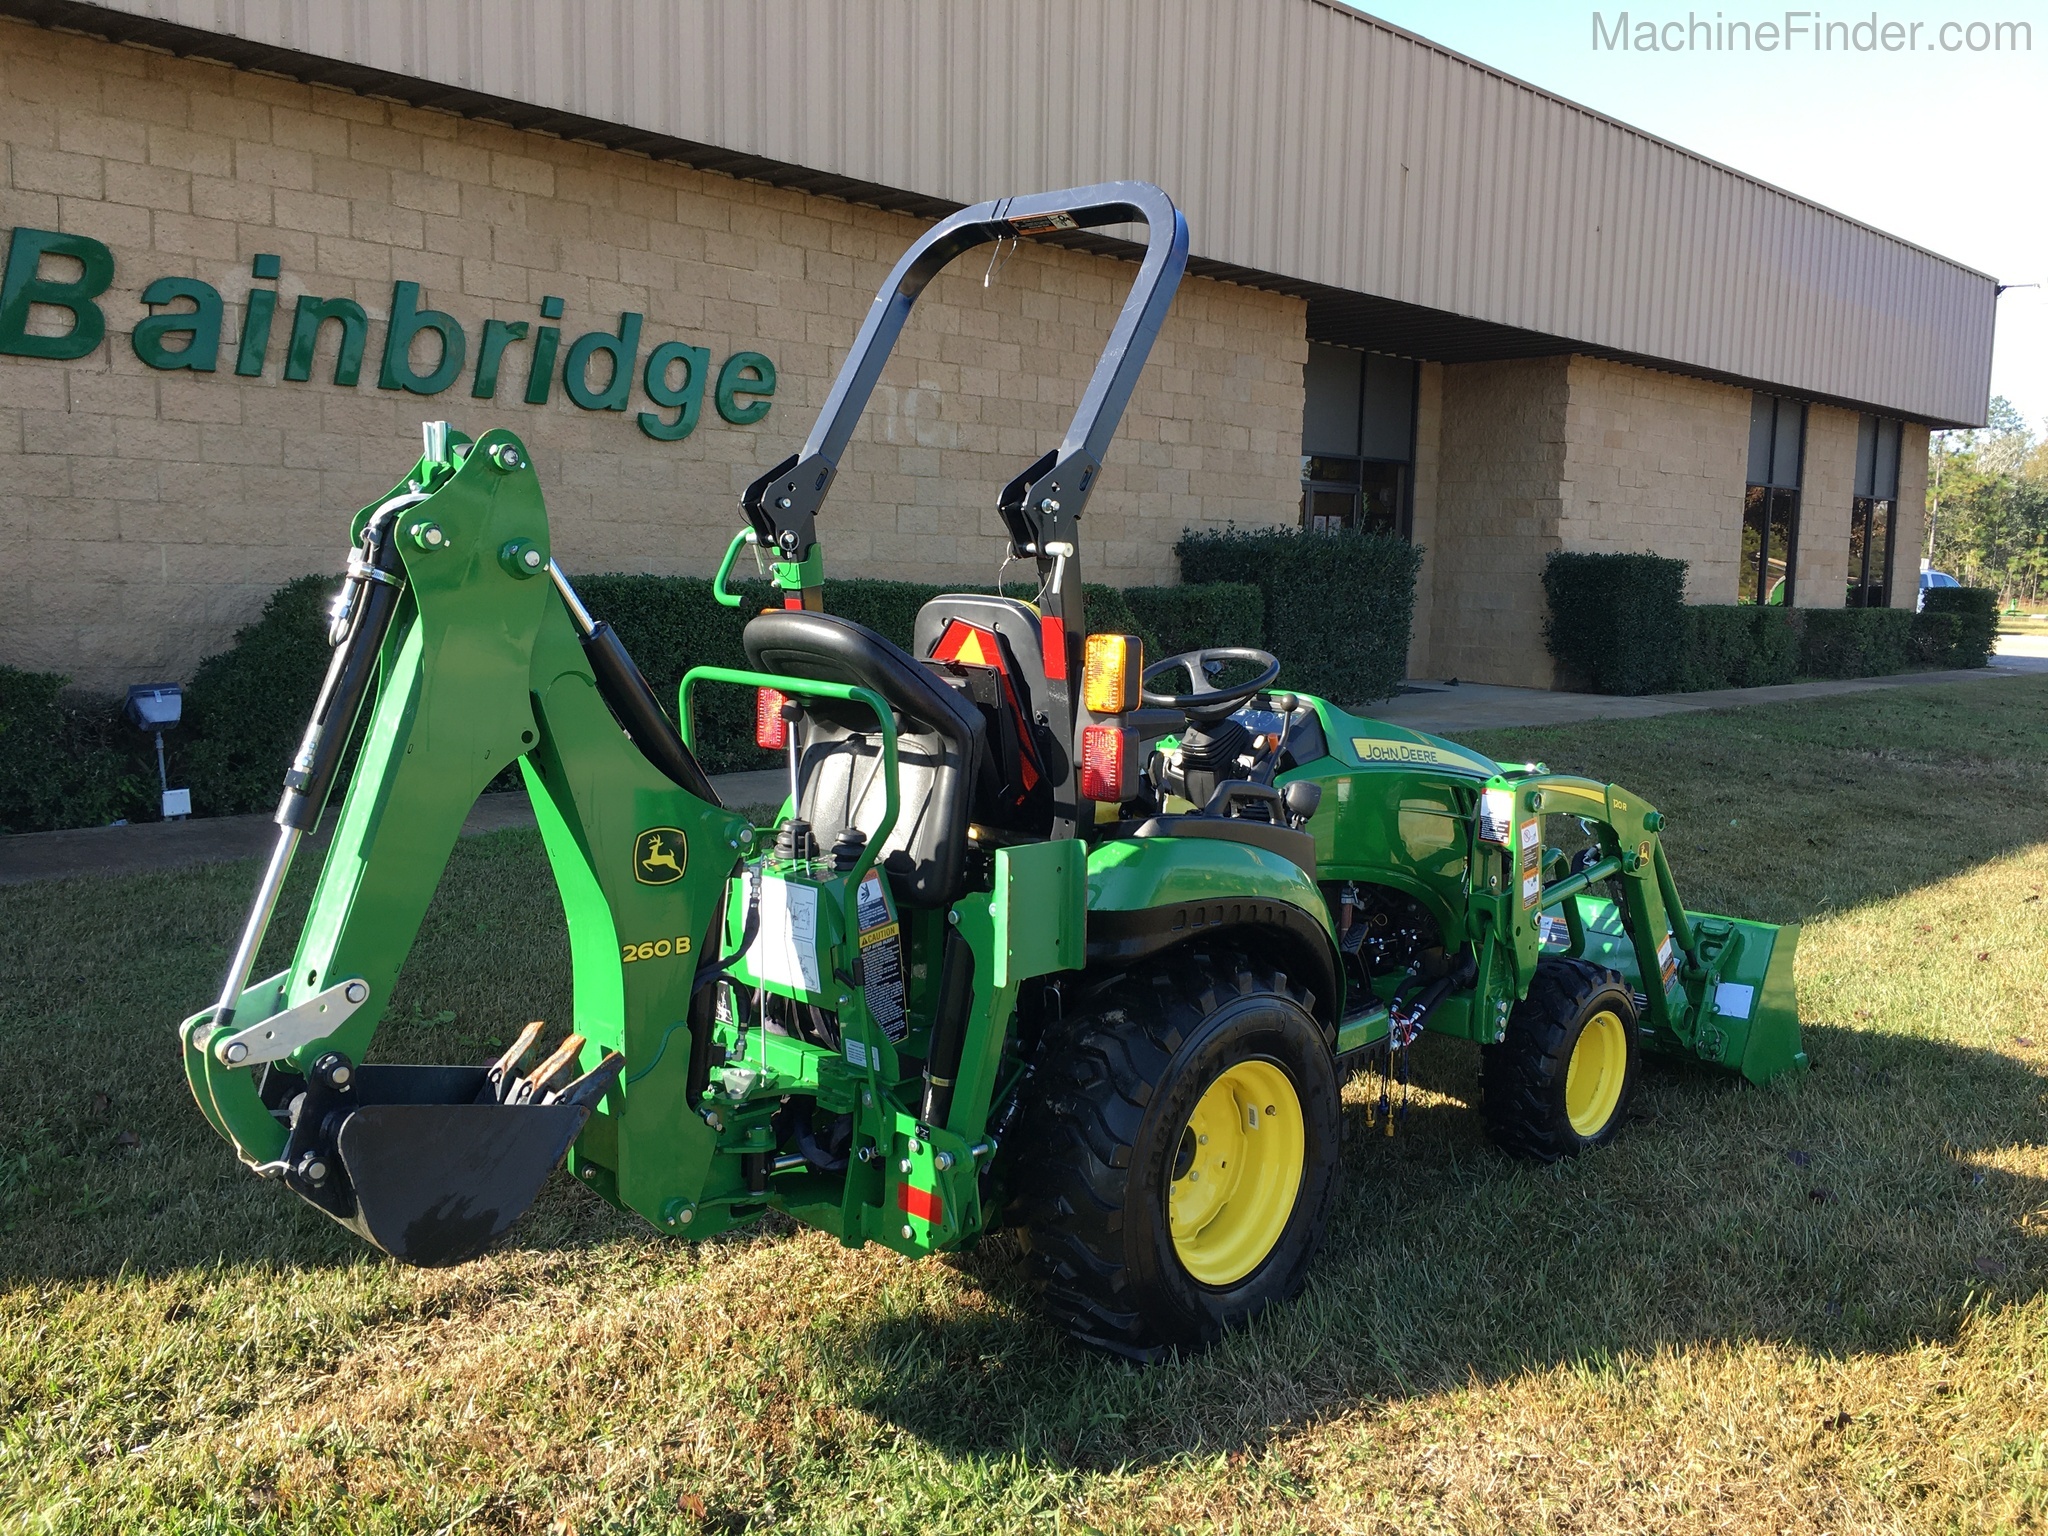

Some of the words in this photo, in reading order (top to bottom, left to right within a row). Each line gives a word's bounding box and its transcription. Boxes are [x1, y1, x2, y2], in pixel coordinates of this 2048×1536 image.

[0, 226, 777, 441] Bainbridge
[1366, 744, 1399, 759] JOHN
[1400, 746, 1438, 762] DEERE
[867, 926, 896, 943] CAUTION
[622, 938, 672, 963] 260
[675, 936, 692, 955] B
